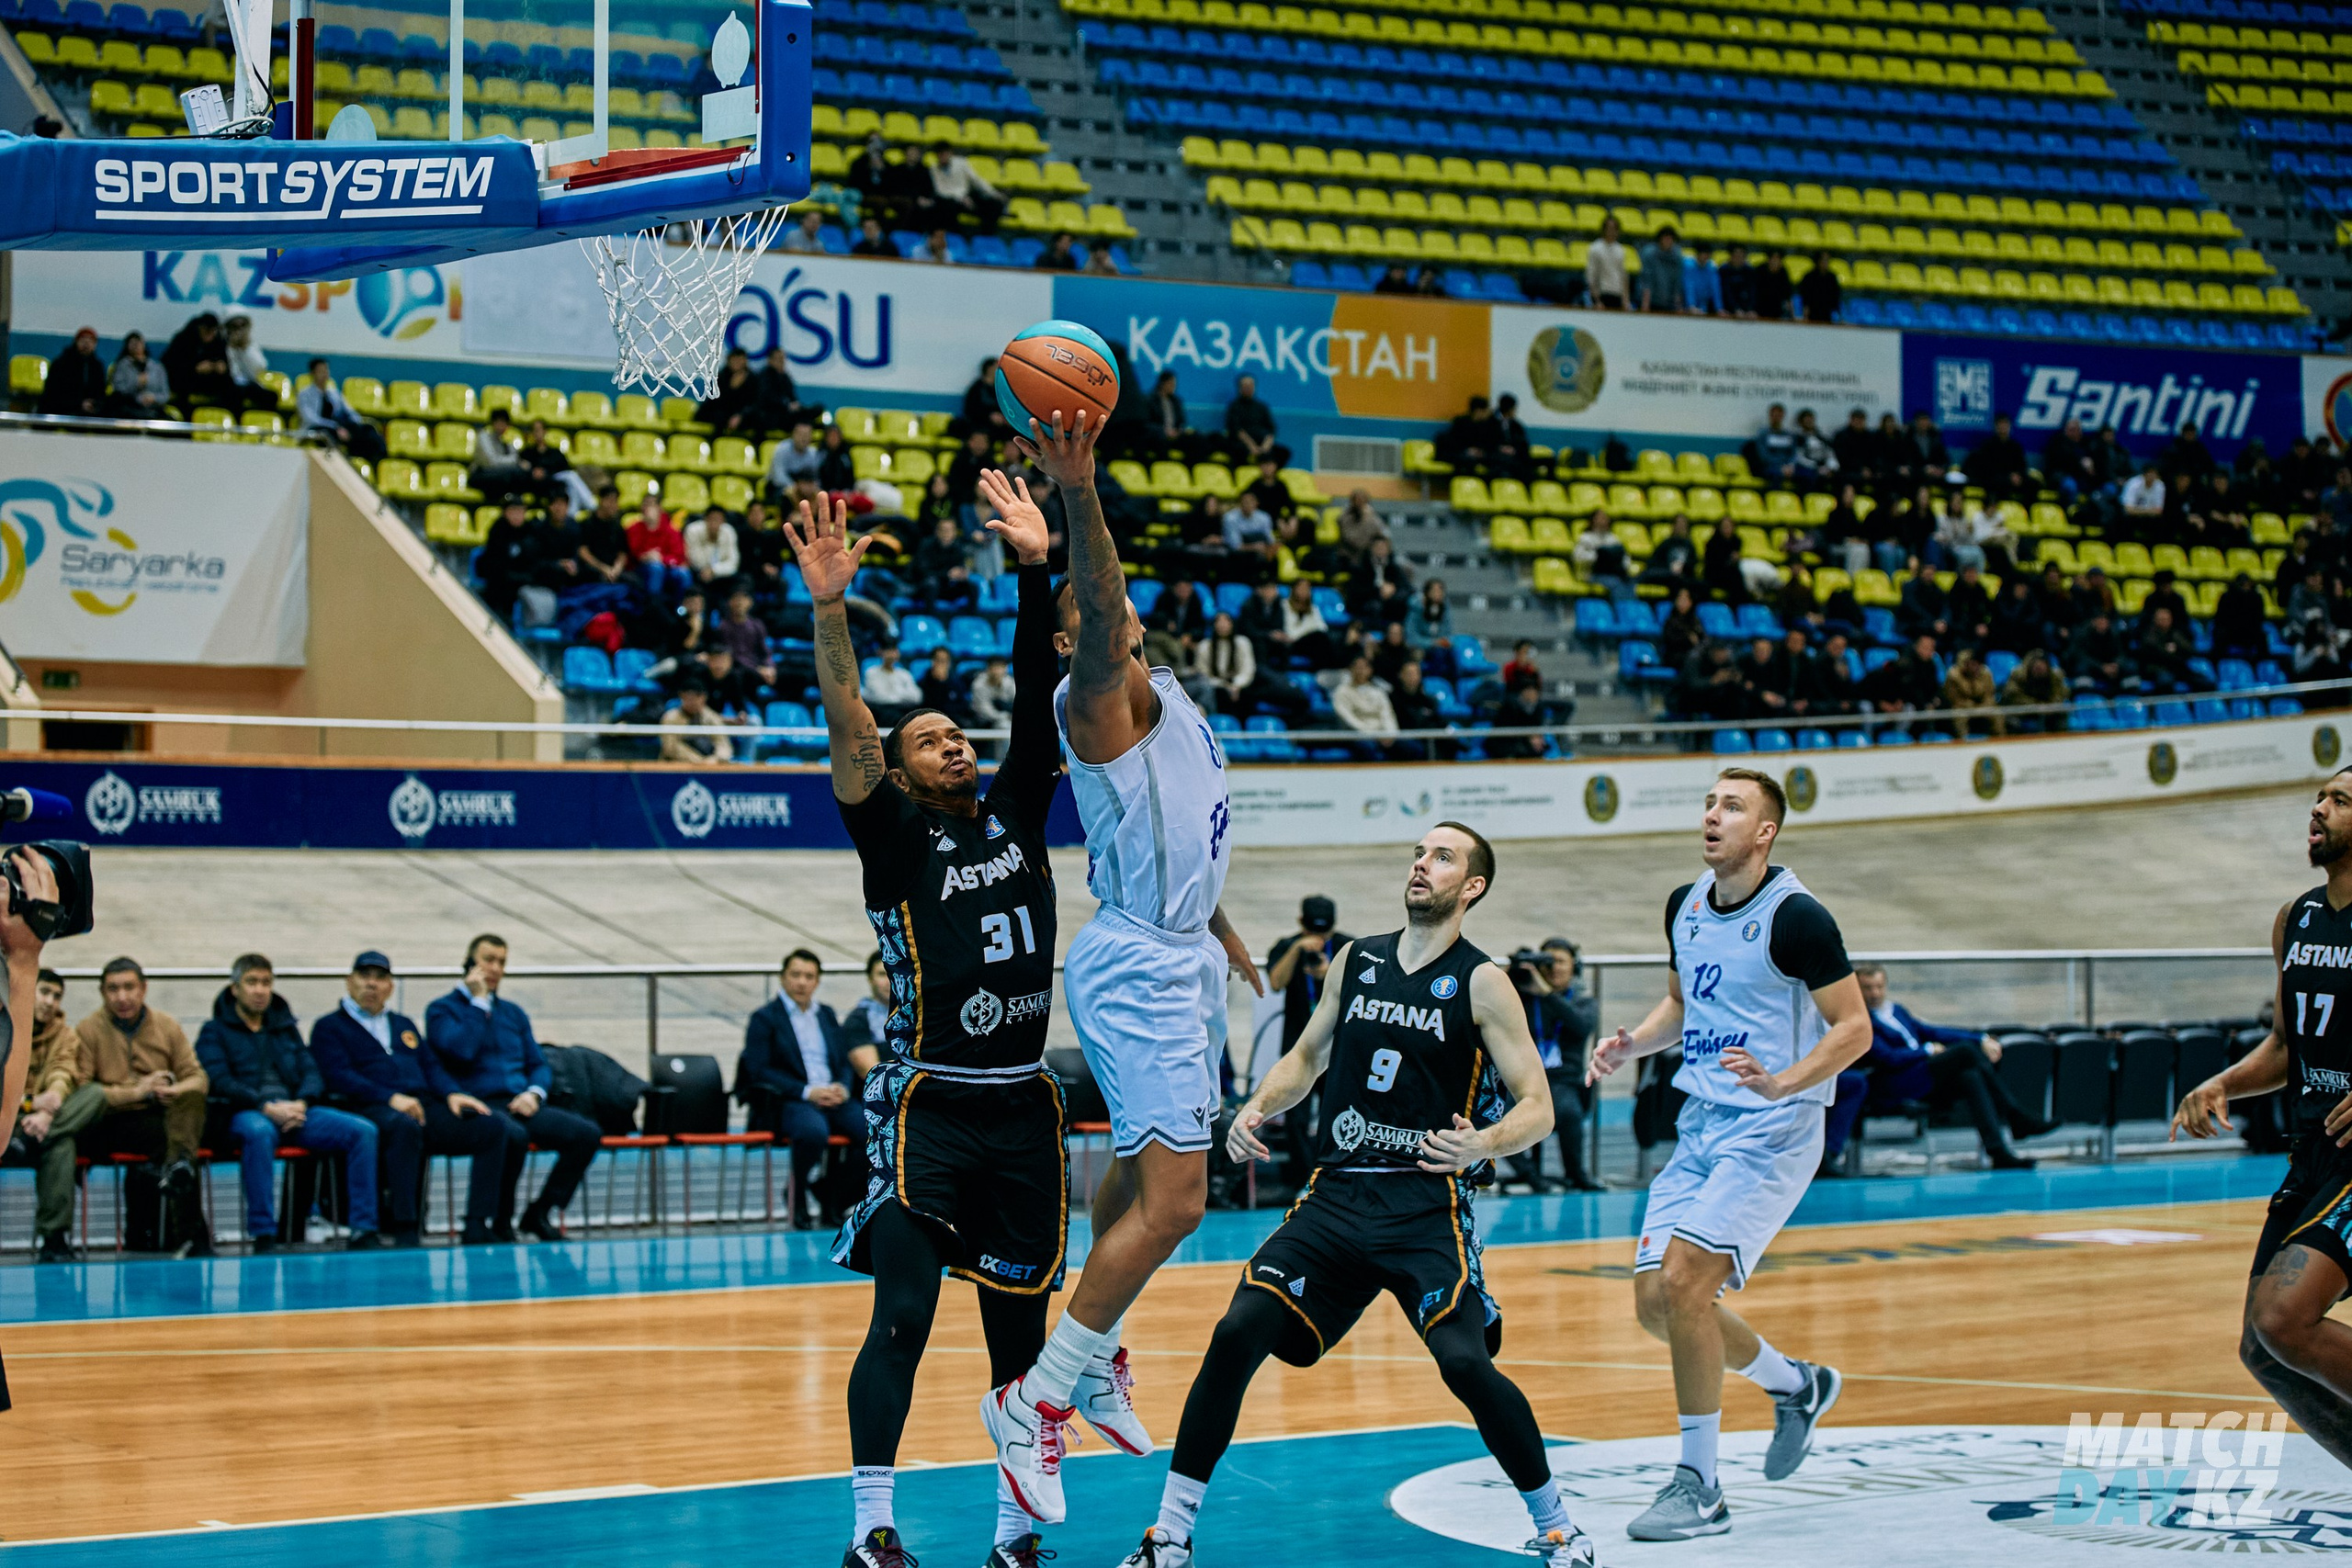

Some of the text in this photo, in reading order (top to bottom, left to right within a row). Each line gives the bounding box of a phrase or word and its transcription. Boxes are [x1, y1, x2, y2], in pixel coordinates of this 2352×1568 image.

[1129, 316, 1439, 382] ҚАЗАҚСТАН
[2017, 366, 2260, 440] Santini
[60, 543, 226, 588] Saryarka
[940, 842, 1030, 901] ASTANA
[980, 905, 1035, 964] 31
[1692, 963, 1723, 1001] 12
[1345, 994, 1445, 1043] ASTANA
[2295, 992, 2335, 1037] 17
[1366, 1048, 1403, 1093] 9
[978, 1254, 1037, 1280] 1XBET
